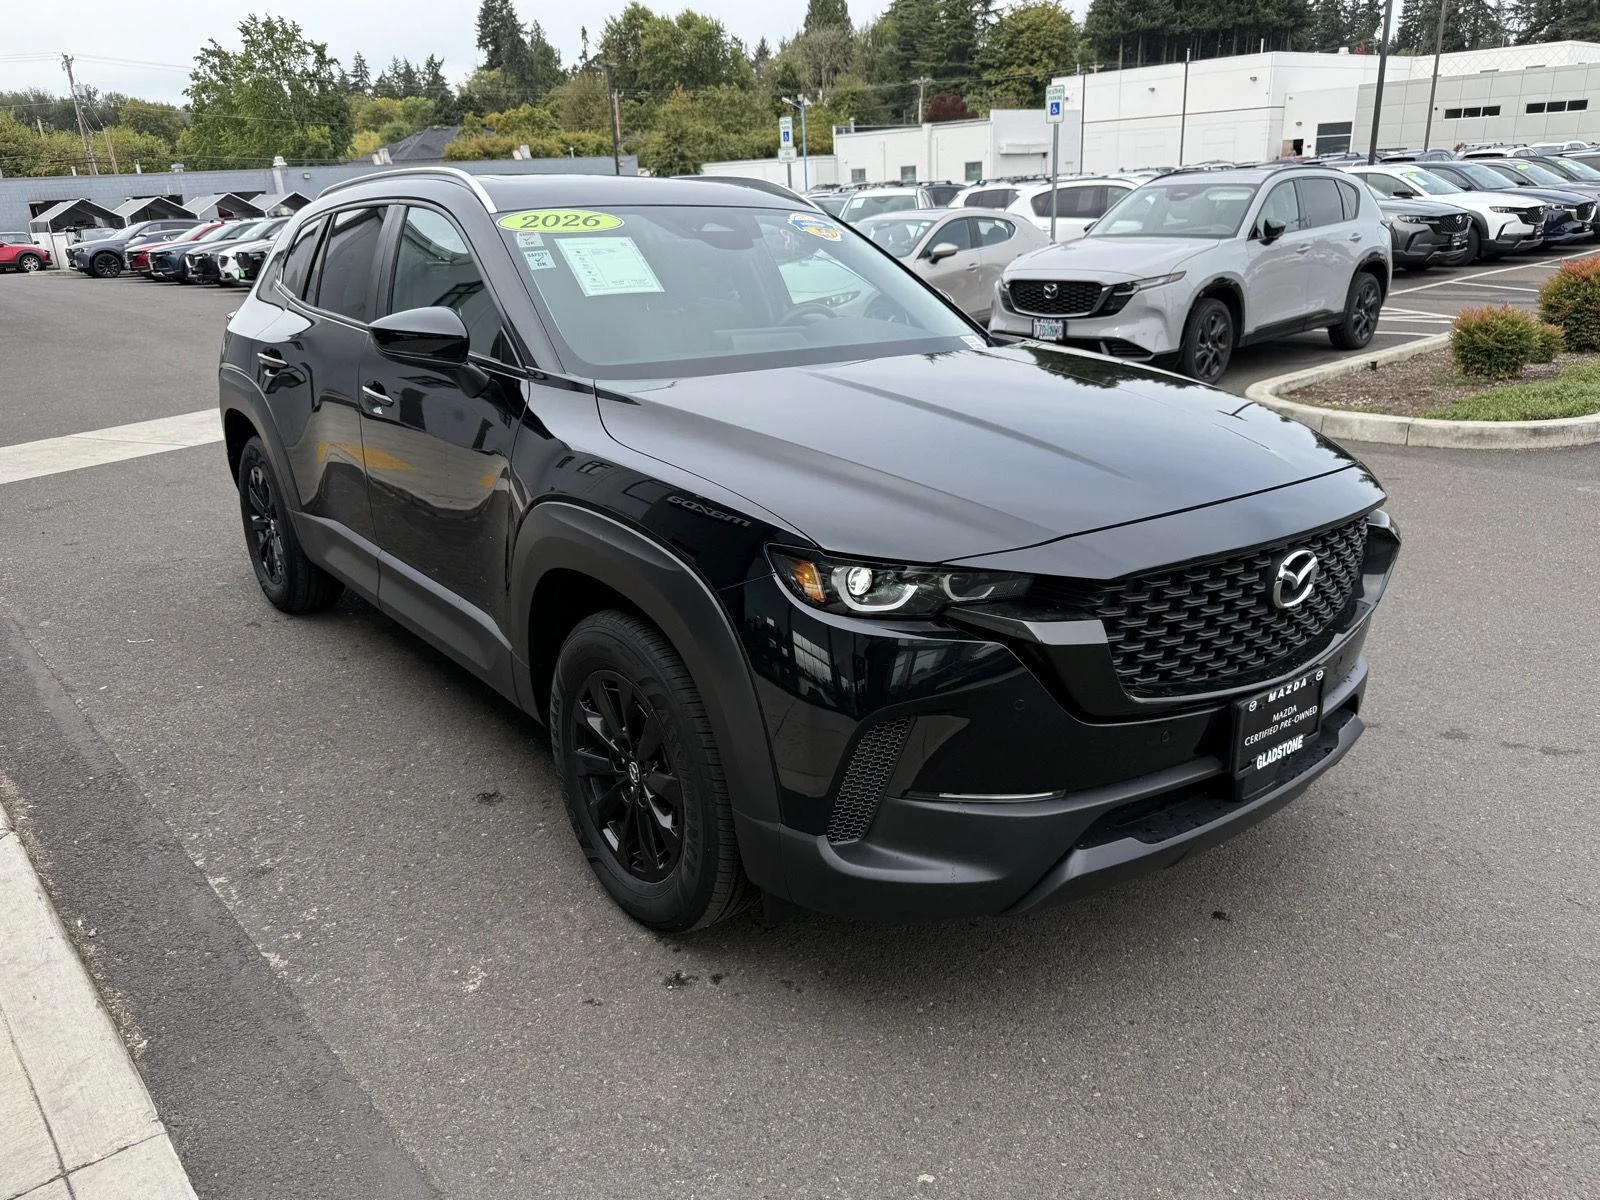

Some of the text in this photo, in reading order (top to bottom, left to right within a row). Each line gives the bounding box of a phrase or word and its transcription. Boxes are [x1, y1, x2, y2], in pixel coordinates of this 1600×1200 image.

[520, 214, 601, 228] 2026
[1268, 678, 1307, 702] MAZDA
[1244, 705, 1318, 746] CERTIFIED PRE-OWNED
[1272, 704, 1297, 723] MAZDA
[1256, 735, 1304, 769] GLADSTONE
